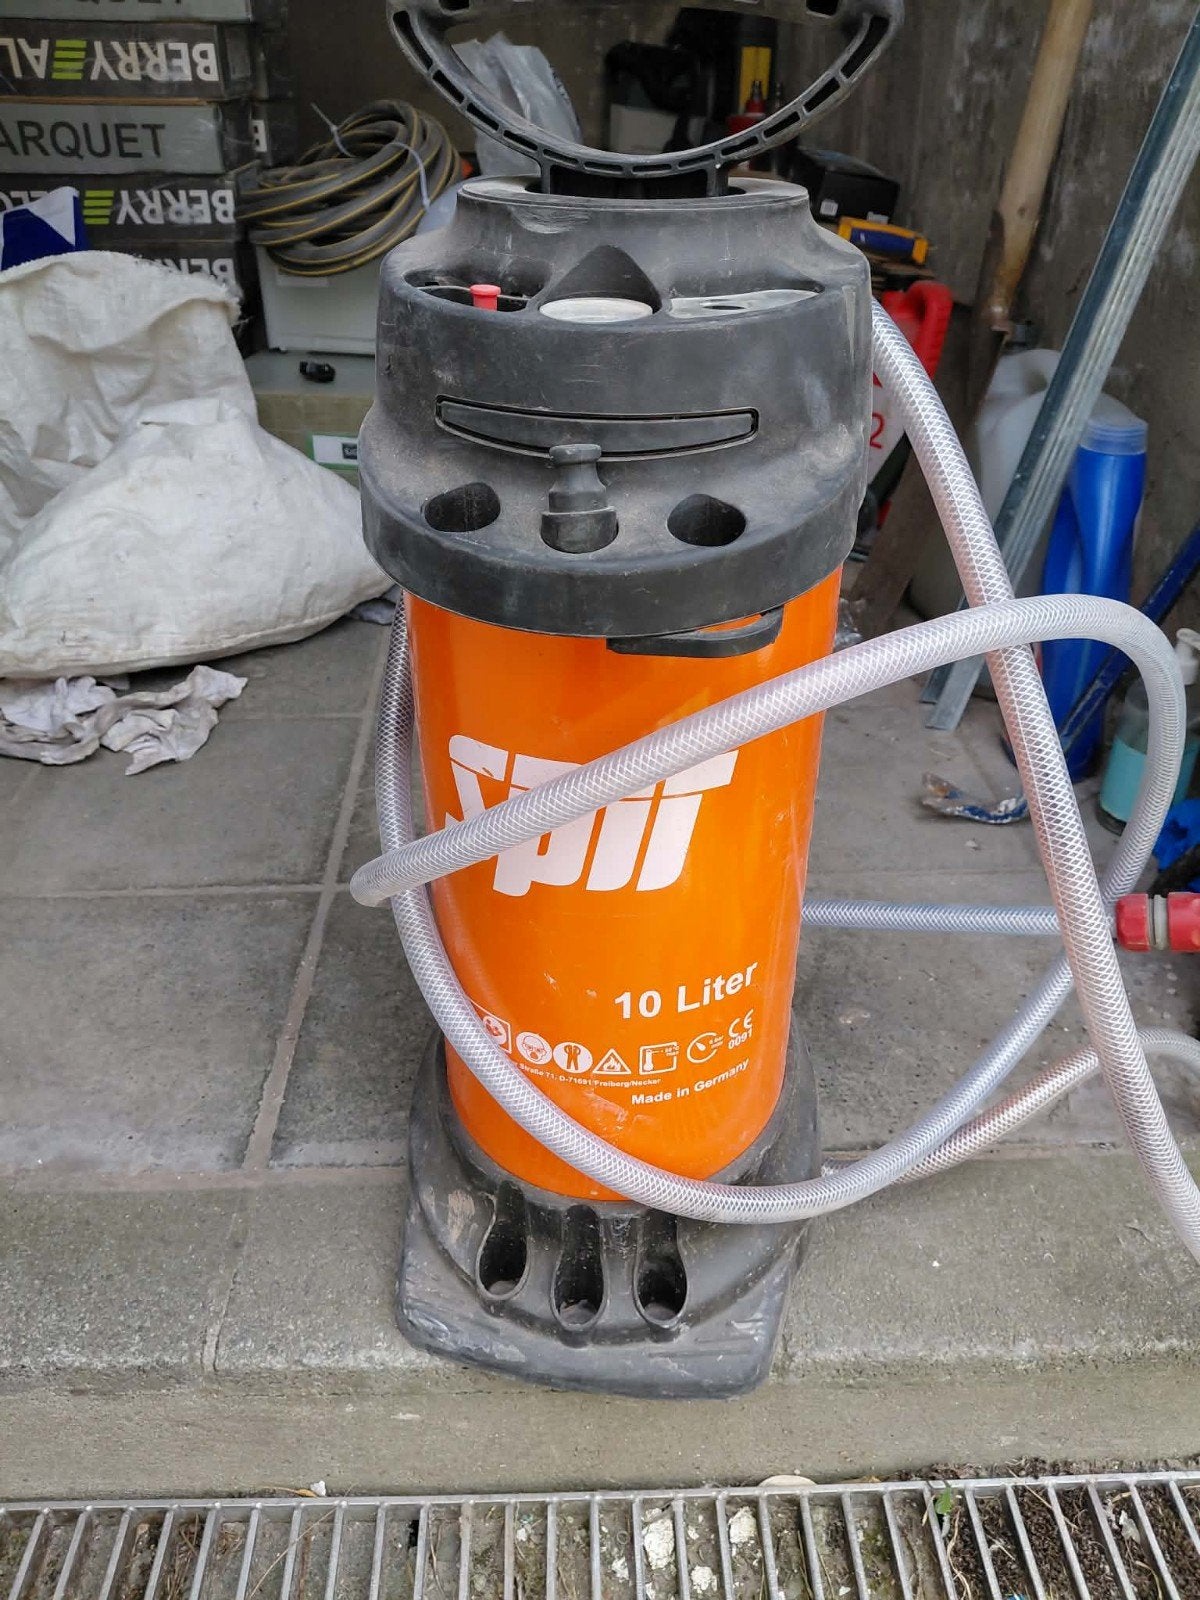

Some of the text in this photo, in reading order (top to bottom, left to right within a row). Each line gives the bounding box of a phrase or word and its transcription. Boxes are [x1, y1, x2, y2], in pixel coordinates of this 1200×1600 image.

[90, 40, 219, 82] BERRY
[116, 189, 236, 225] BERRY
[614, 962, 758, 1019] 10 Liter
[631, 1058, 750, 1105] Made in Germany
